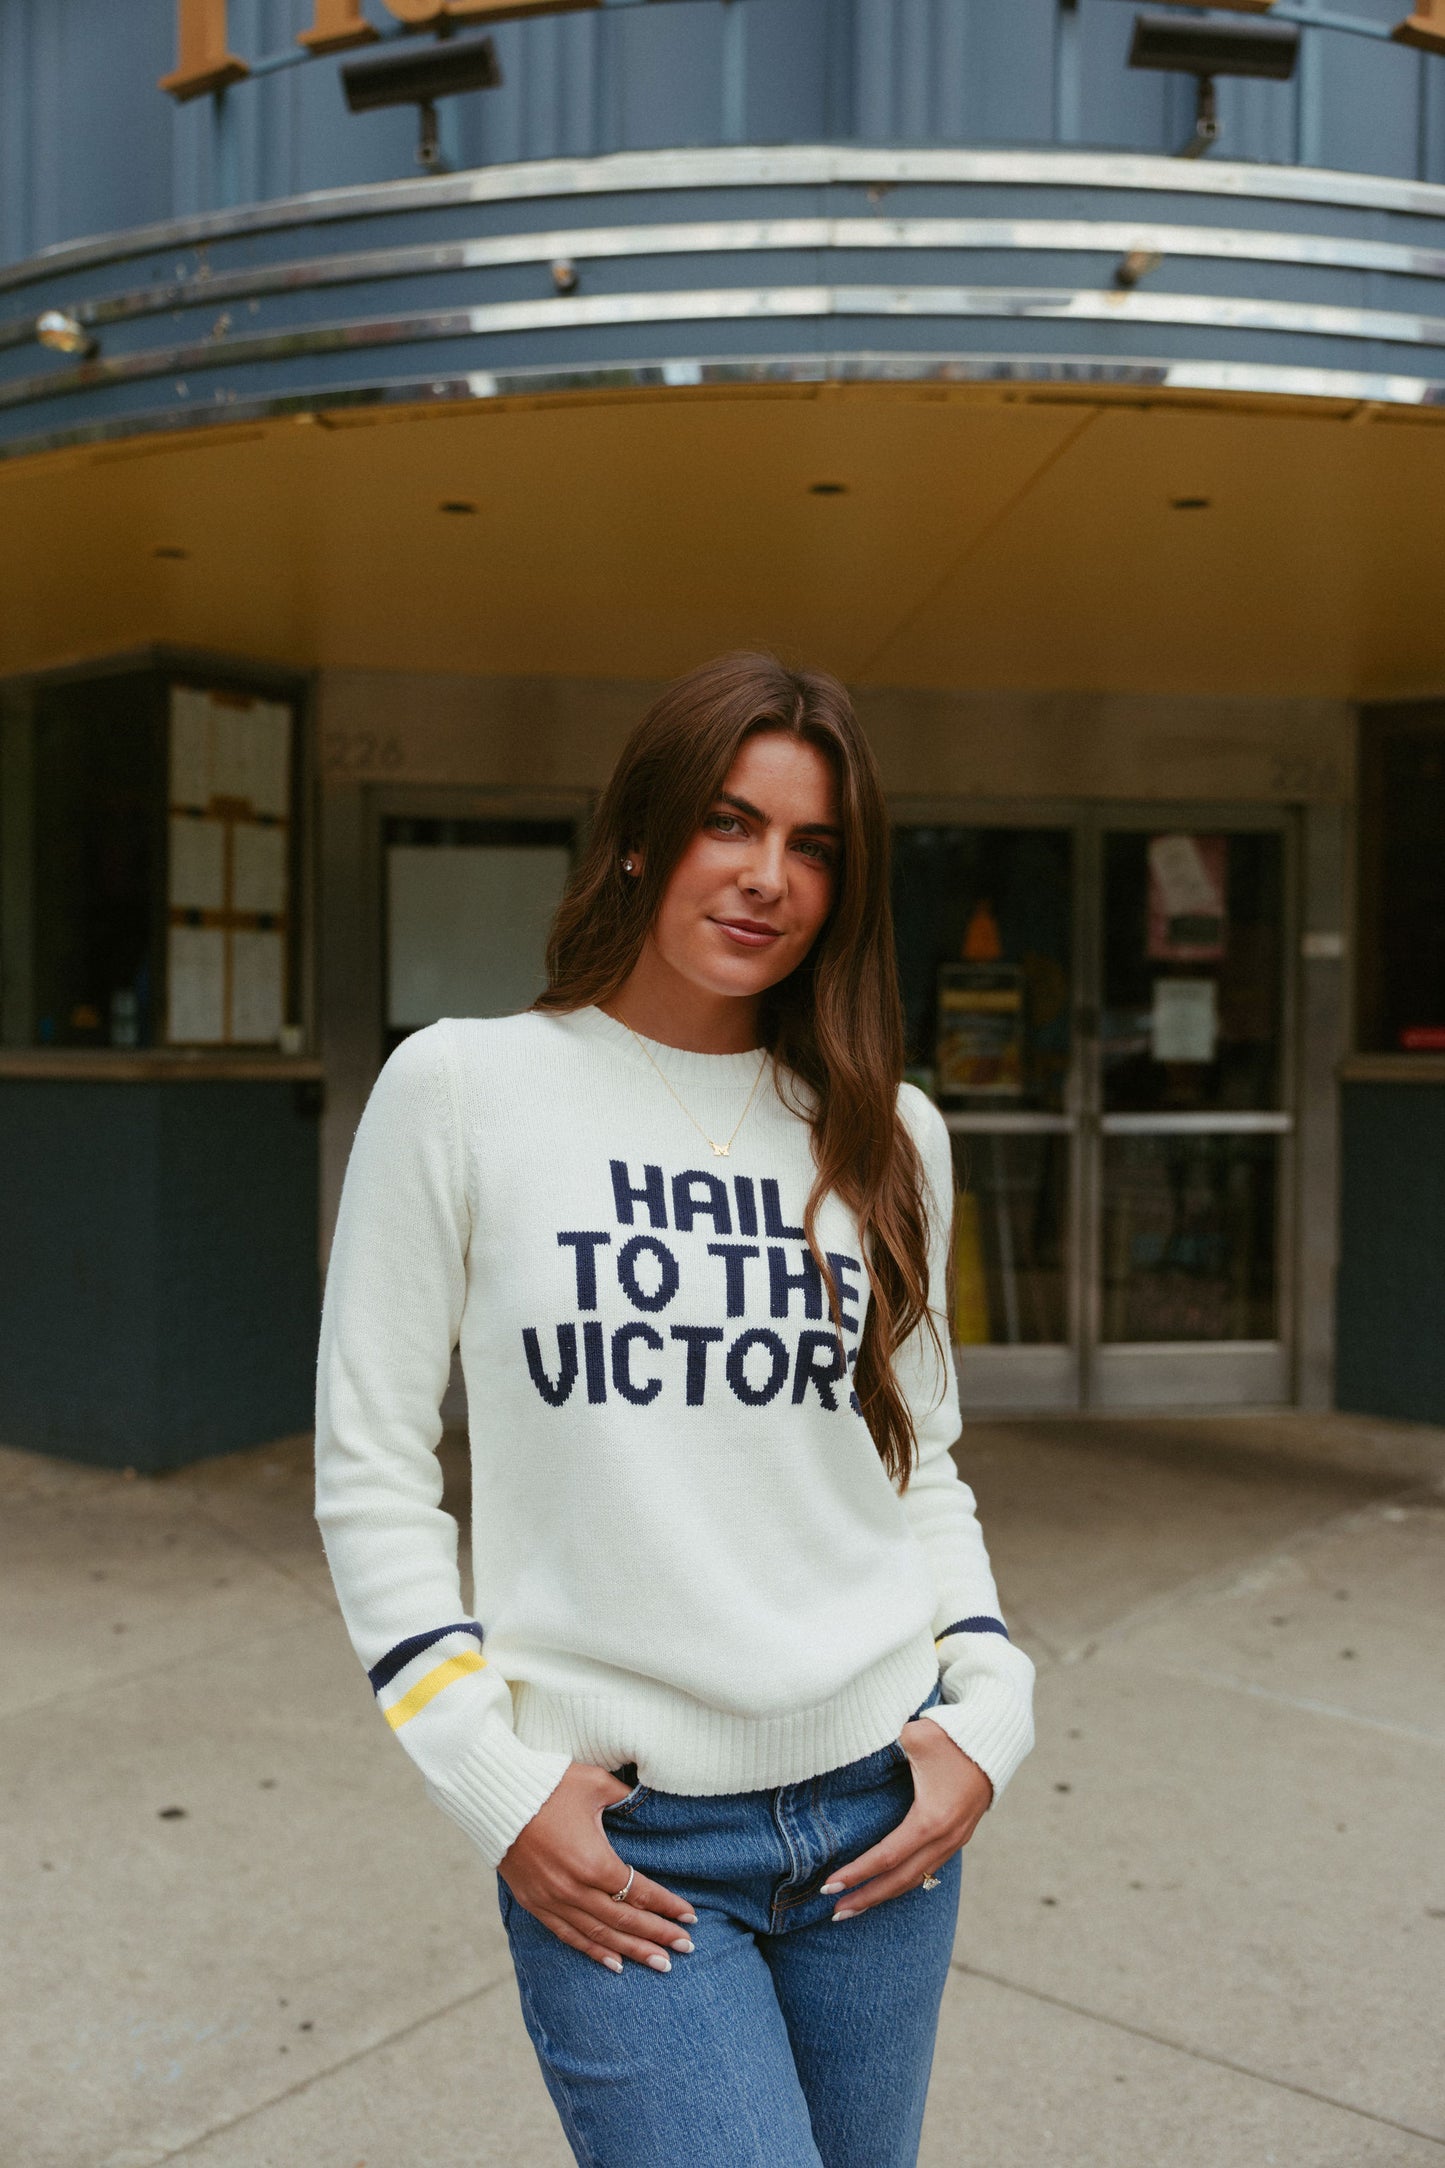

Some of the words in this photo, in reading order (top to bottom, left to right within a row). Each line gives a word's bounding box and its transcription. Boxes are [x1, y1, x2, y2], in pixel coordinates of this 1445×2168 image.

[326, 731, 404, 770] 226
[609, 1159, 806, 1240] HAIL
[557, 1231, 679, 1313] TO
[708, 1244, 861, 1334] THE
